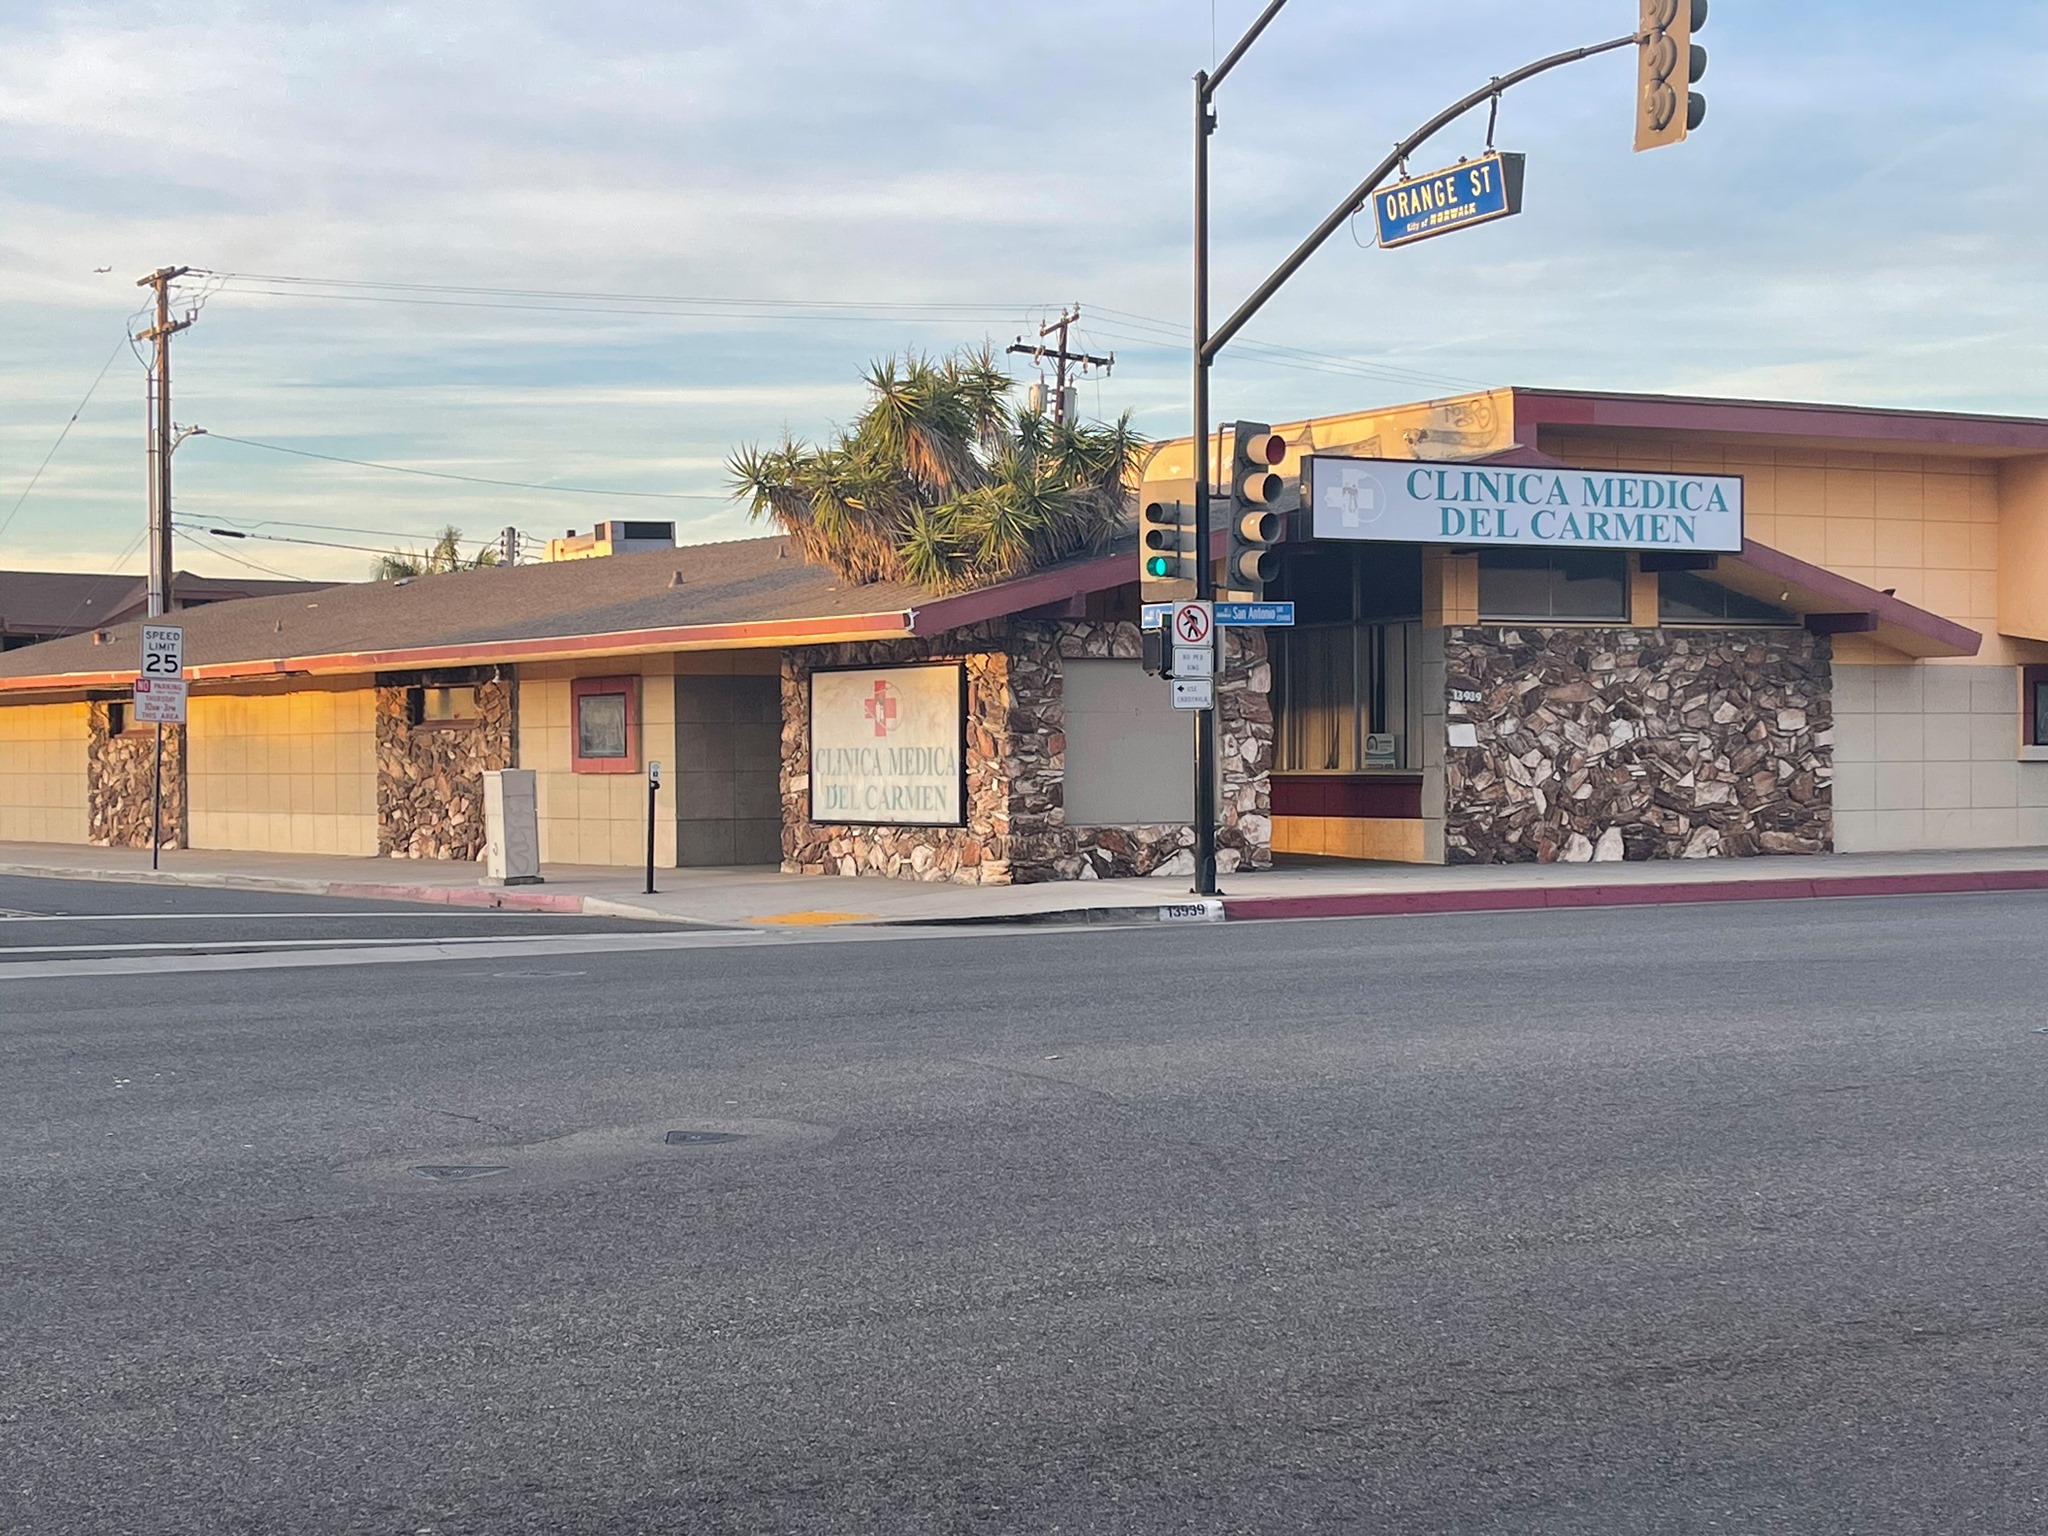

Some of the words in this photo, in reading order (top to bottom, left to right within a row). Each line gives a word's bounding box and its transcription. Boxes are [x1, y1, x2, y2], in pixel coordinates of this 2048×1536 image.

[1386, 176, 1457, 221] ORANGE
[1470, 166, 1490, 196] ST
[1406, 467, 1570, 506] CLINICA
[1581, 477, 1729, 513] MEDICA
[1439, 506, 1519, 538] DEL
[1530, 510, 1696, 544] CARMEN
[1232, 606, 1247, 620] San
[1248, 606, 1276, 620] Antonio
[145, 630, 180, 641] SPEED
[149, 642, 176, 651] LIMIT
[146, 653, 178, 673] 25
[137, 681, 149, 691] NO
[154, 683, 182, 691] PARKING
[1452, 688, 1482, 702] 13939
[815, 747, 883, 777] CLINICA
[889, 747, 957, 777] MEDICA
[825, 785, 861, 810] DEL
[865, 785, 947, 811] CARMEN
[1167, 903, 1205, 918] 13939
